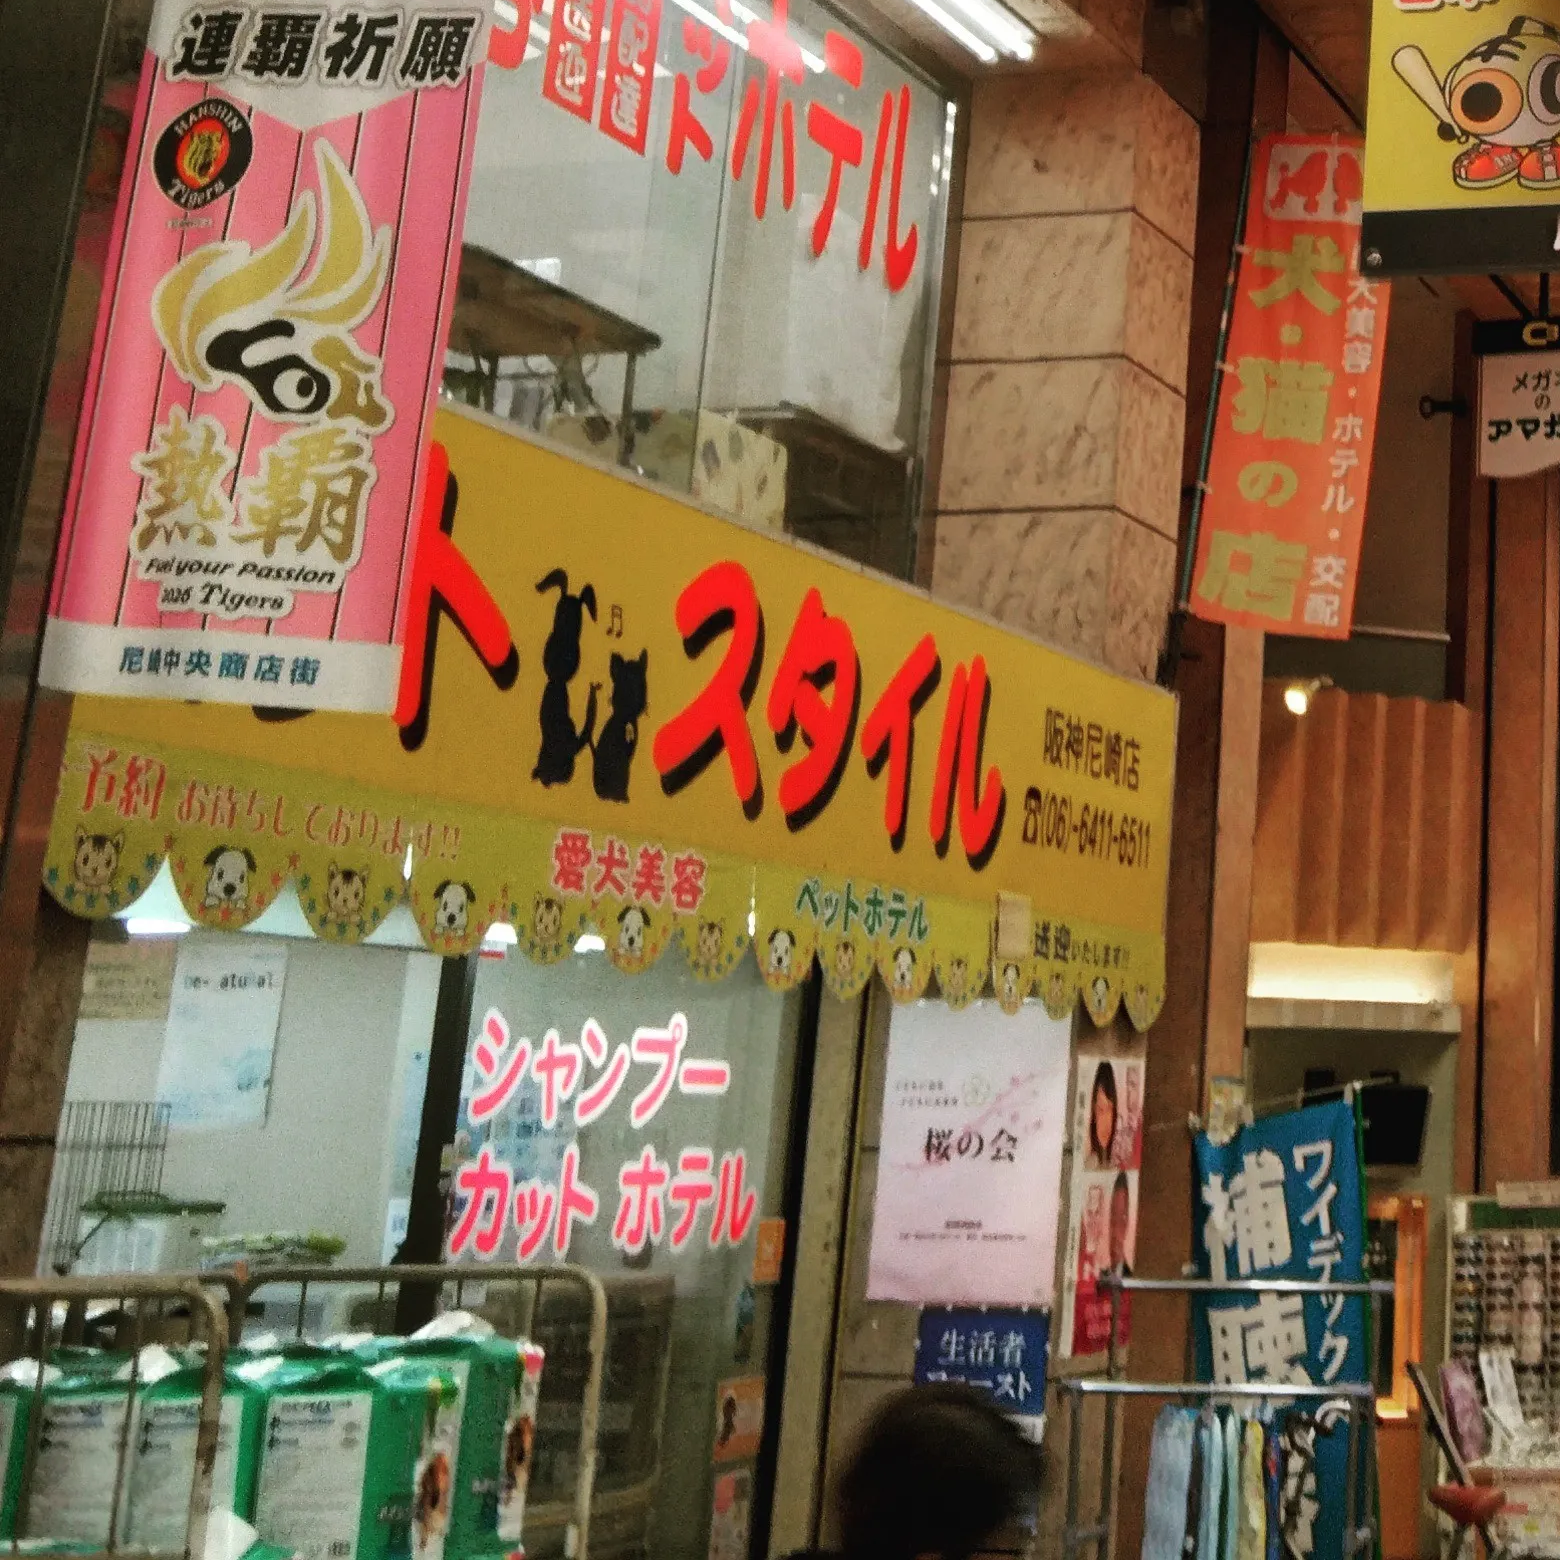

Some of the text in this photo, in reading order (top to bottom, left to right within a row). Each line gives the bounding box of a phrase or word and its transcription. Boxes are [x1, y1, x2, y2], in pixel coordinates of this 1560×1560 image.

[171, 11, 479, 83] 連覇祈願
[173, 102, 243, 138] HANSHIN
[1198, 233, 1347, 623] 犬・猫の店
[1533, 392, 1551, 411] の
[1303, 248, 1380, 628] 犬美容・ホテル・交配
[173, 558, 231, 581] your
[236, 562, 337, 586] Passion
[198, 581, 285, 612] Tigers
[117, 645, 322, 687] 尼崎中央商店街
[652, 558, 1008, 874] スタイル
[553, 830, 706, 915] 愛犬美容
[795, 878, 930, 942] ペットホテル
[468, 1010, 730, 1128] シャンプー
[923, 1126, 1018, 1163] 桜の会
[448, 1144, 756, 1262] カット ホテル
[938, 1328, 1027, 1369] 生活者
